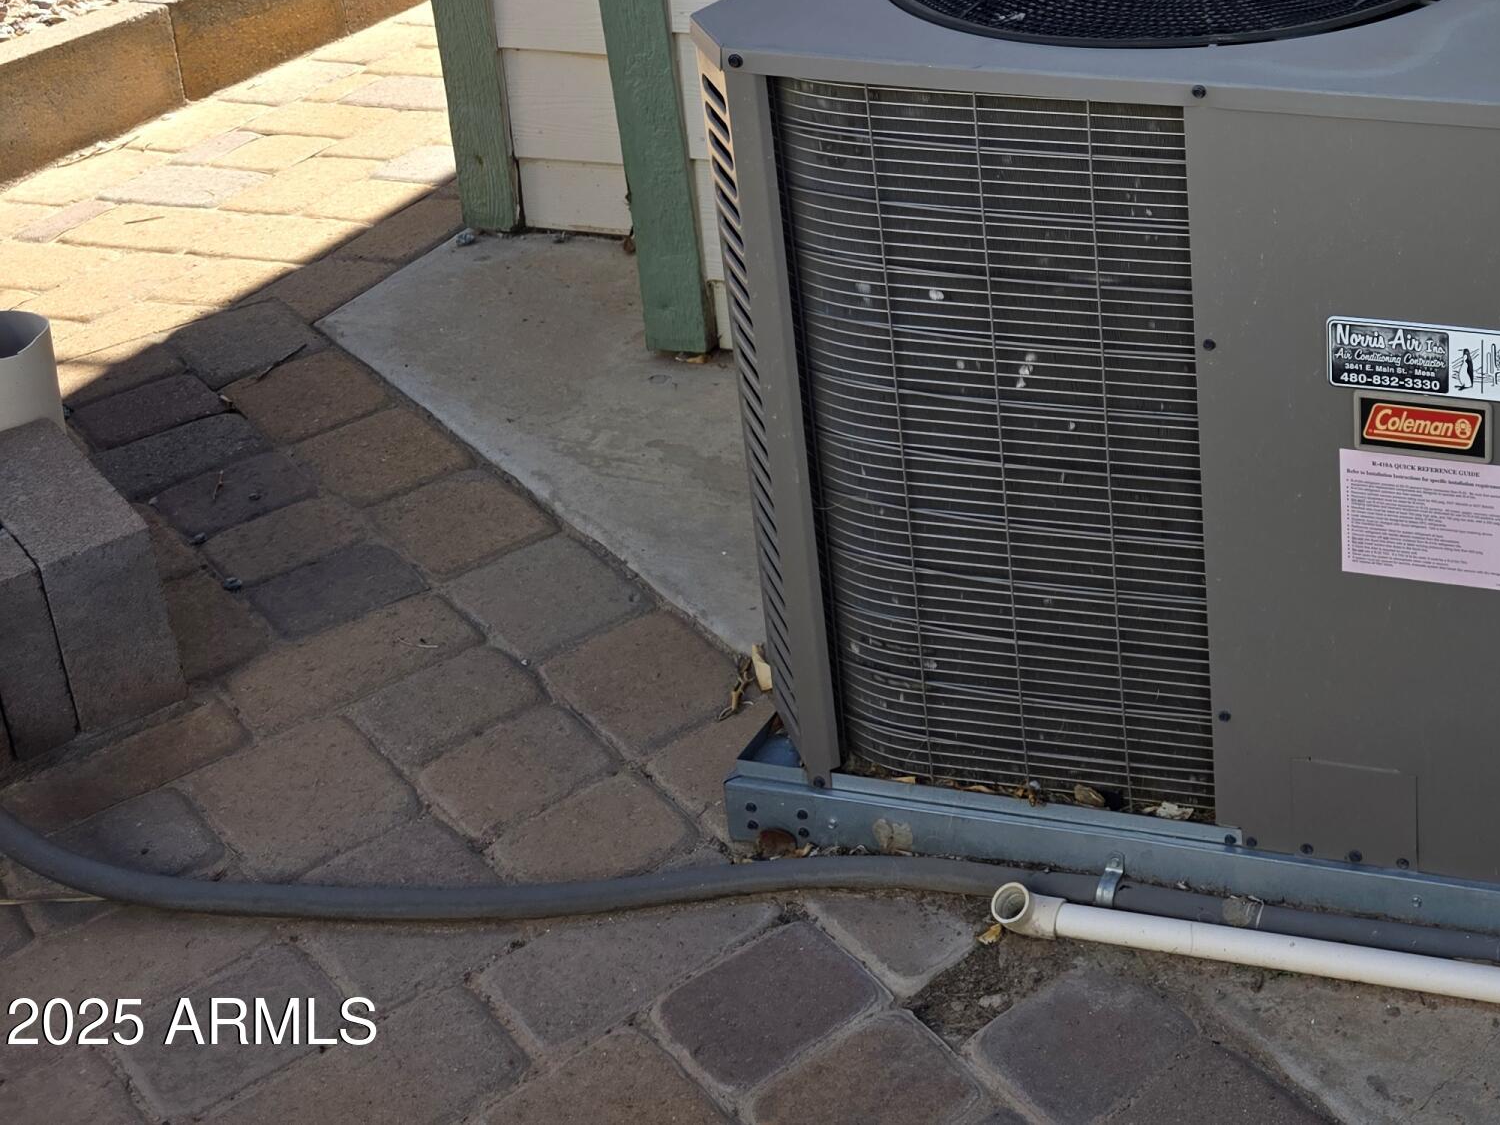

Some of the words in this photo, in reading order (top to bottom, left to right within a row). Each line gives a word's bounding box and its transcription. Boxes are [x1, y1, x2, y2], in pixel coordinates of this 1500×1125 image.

[1336, 323, 1385, 348] Norris
[1389, 329, 1421, 352] Air
[1334, 347, 1352, 359] Air
[1355, 349, 1401, 366] Conditioning
[1404, 353, 1446, 368] Contractor
[1376, 365, 1394, 373] Main
[1340, 372, 1440, 390] 480-832-3330
[1375, 409, 1453, 436] Coleman
[1417, 466, 1457, 475] REFERENCE
